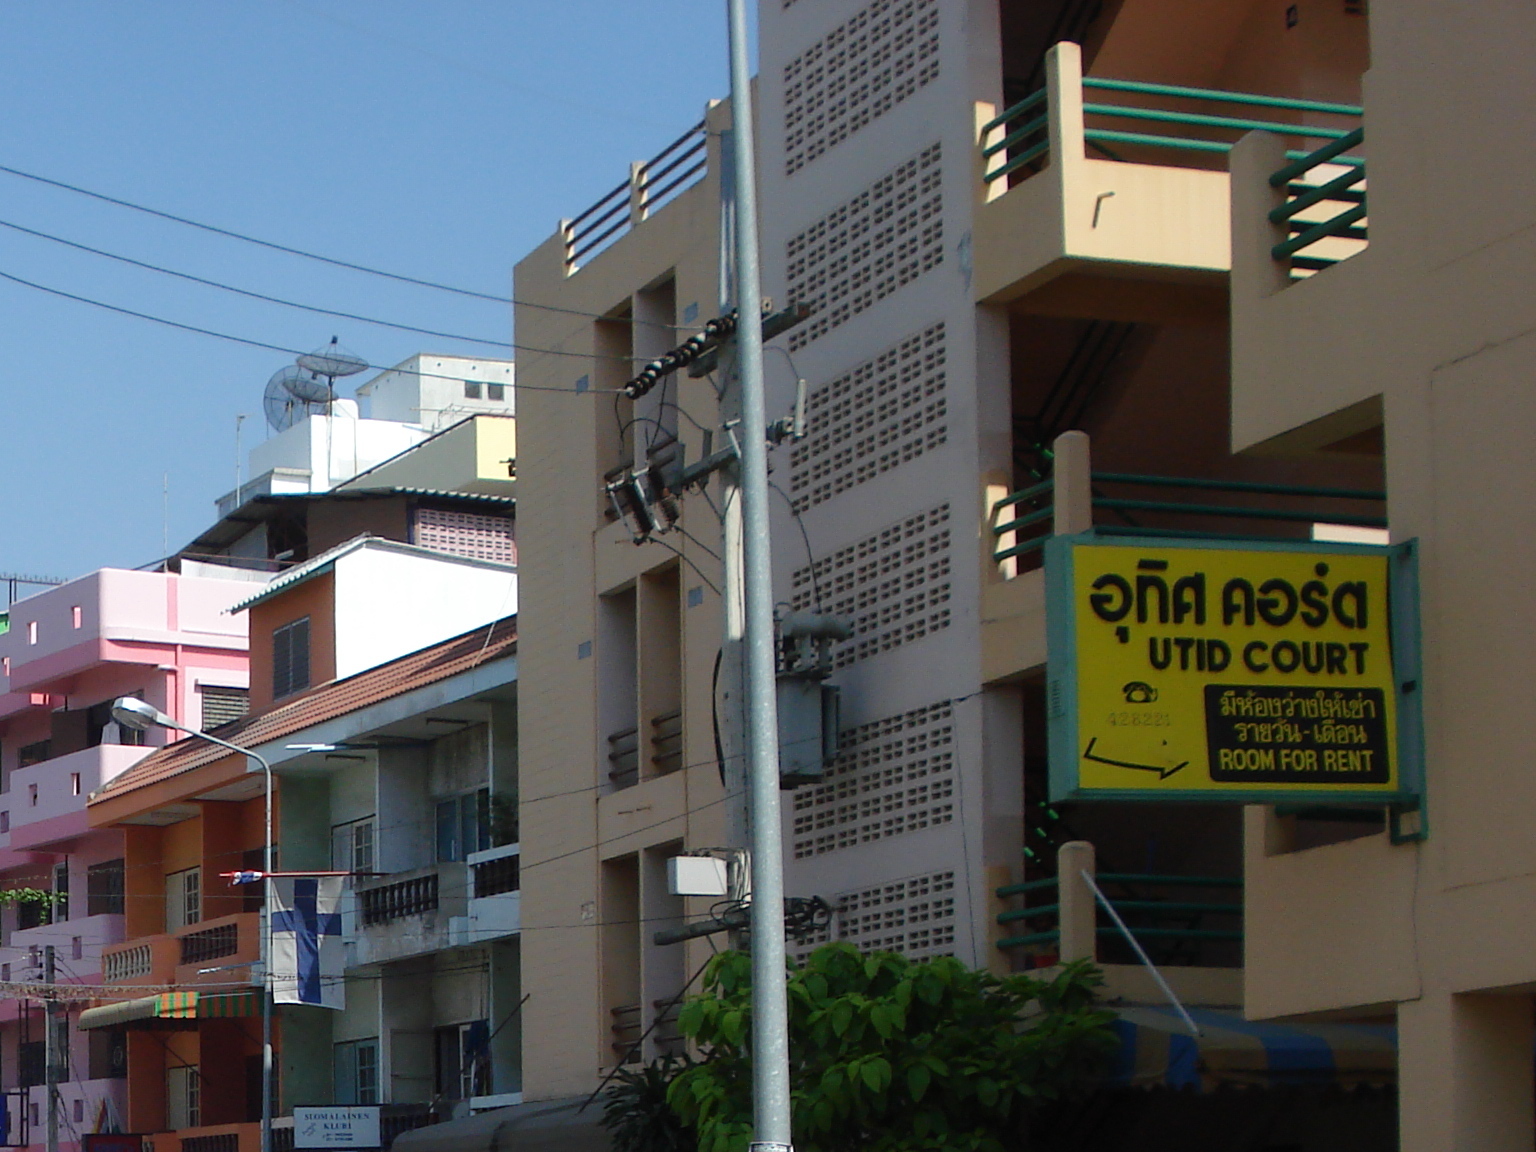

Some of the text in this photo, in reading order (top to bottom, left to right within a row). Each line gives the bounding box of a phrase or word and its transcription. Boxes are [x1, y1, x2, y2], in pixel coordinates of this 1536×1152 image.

[1147, 636, 1369, 676] UTID COURT
[1220, 690, 1376, 718] มีห้องว่างให้เช่า
[1219, 748, 1374, 772] ROOM FOR RENT
[304, 1112, 370, 1120] SUOMALAINEN
[323, 1122, 352, 1130] KLUBI
